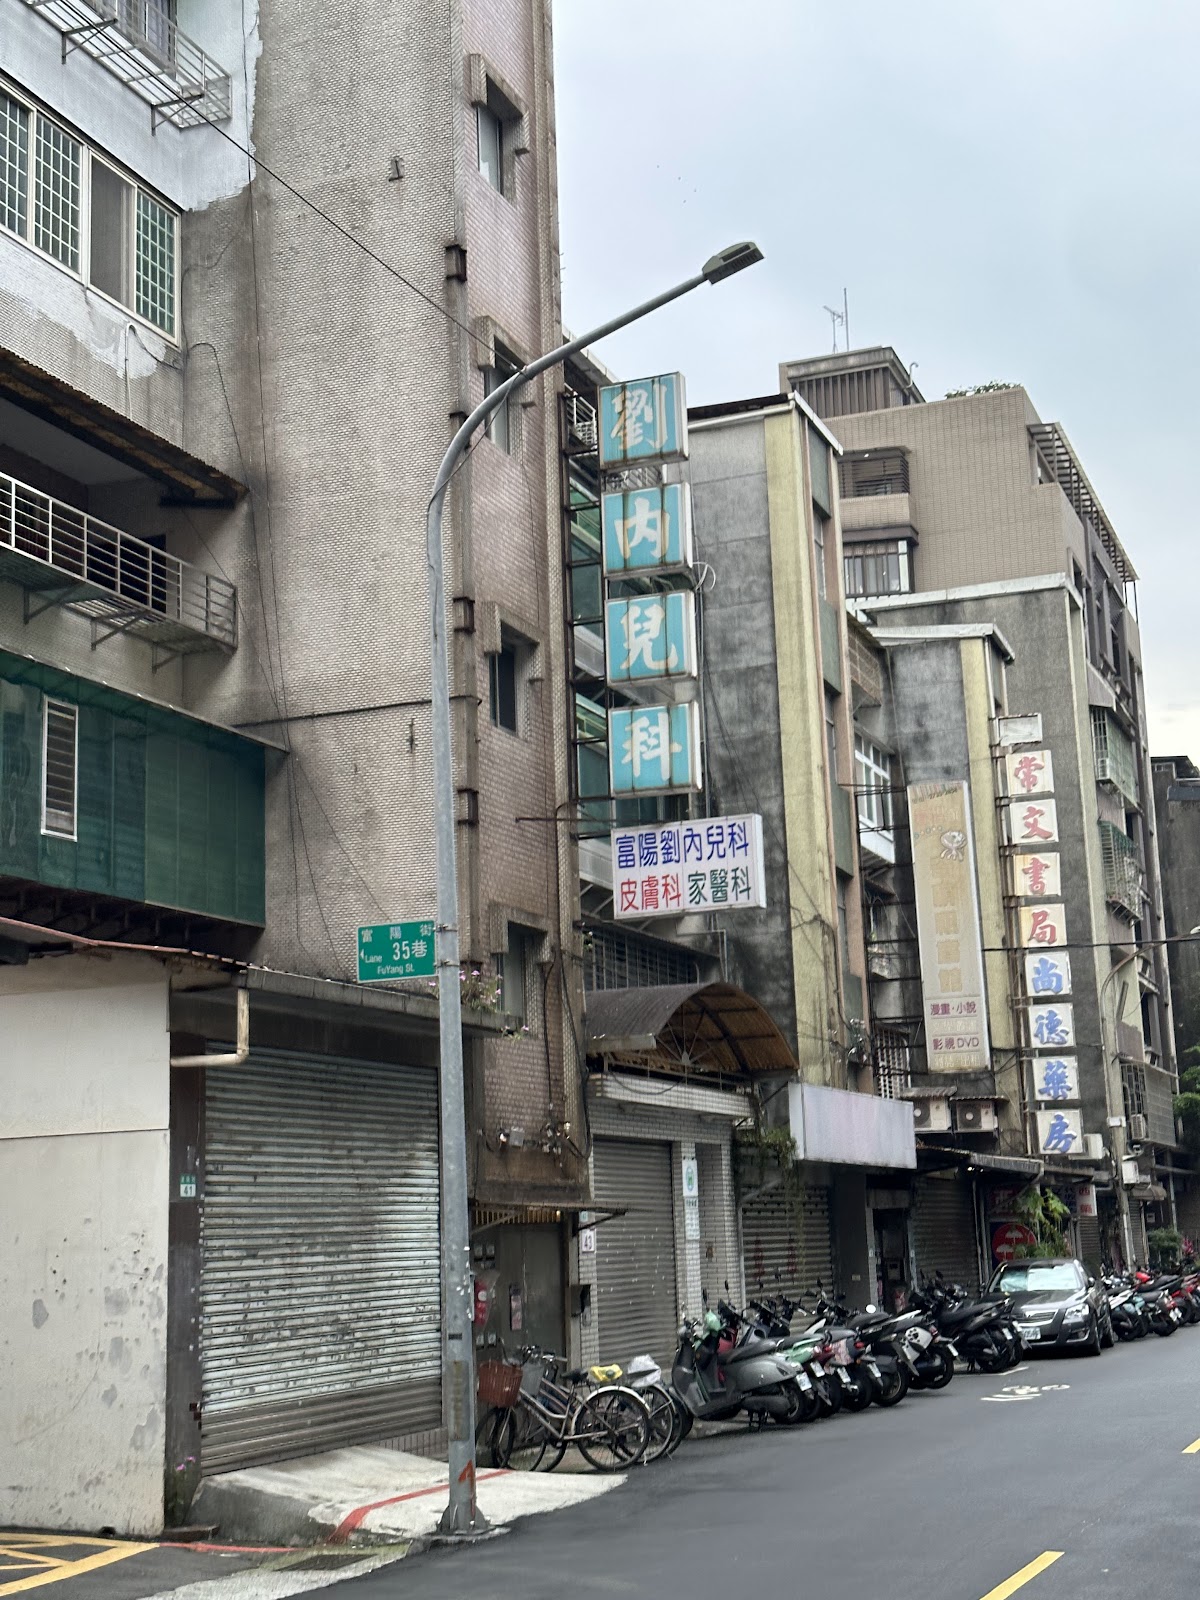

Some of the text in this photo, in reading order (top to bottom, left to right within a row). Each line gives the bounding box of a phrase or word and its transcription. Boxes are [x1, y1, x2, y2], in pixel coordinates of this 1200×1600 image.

[616, 821, 749, 869] 富陽劉內兒科
[620, 866, 751, 912] 皮膚科 家醫科
[365, 954, 383, 963] Lane
[392, 939, 428, 961] 35巷
[183, 1185, 193, 1196] 41
[584, 1234, 593, 1250] 43
